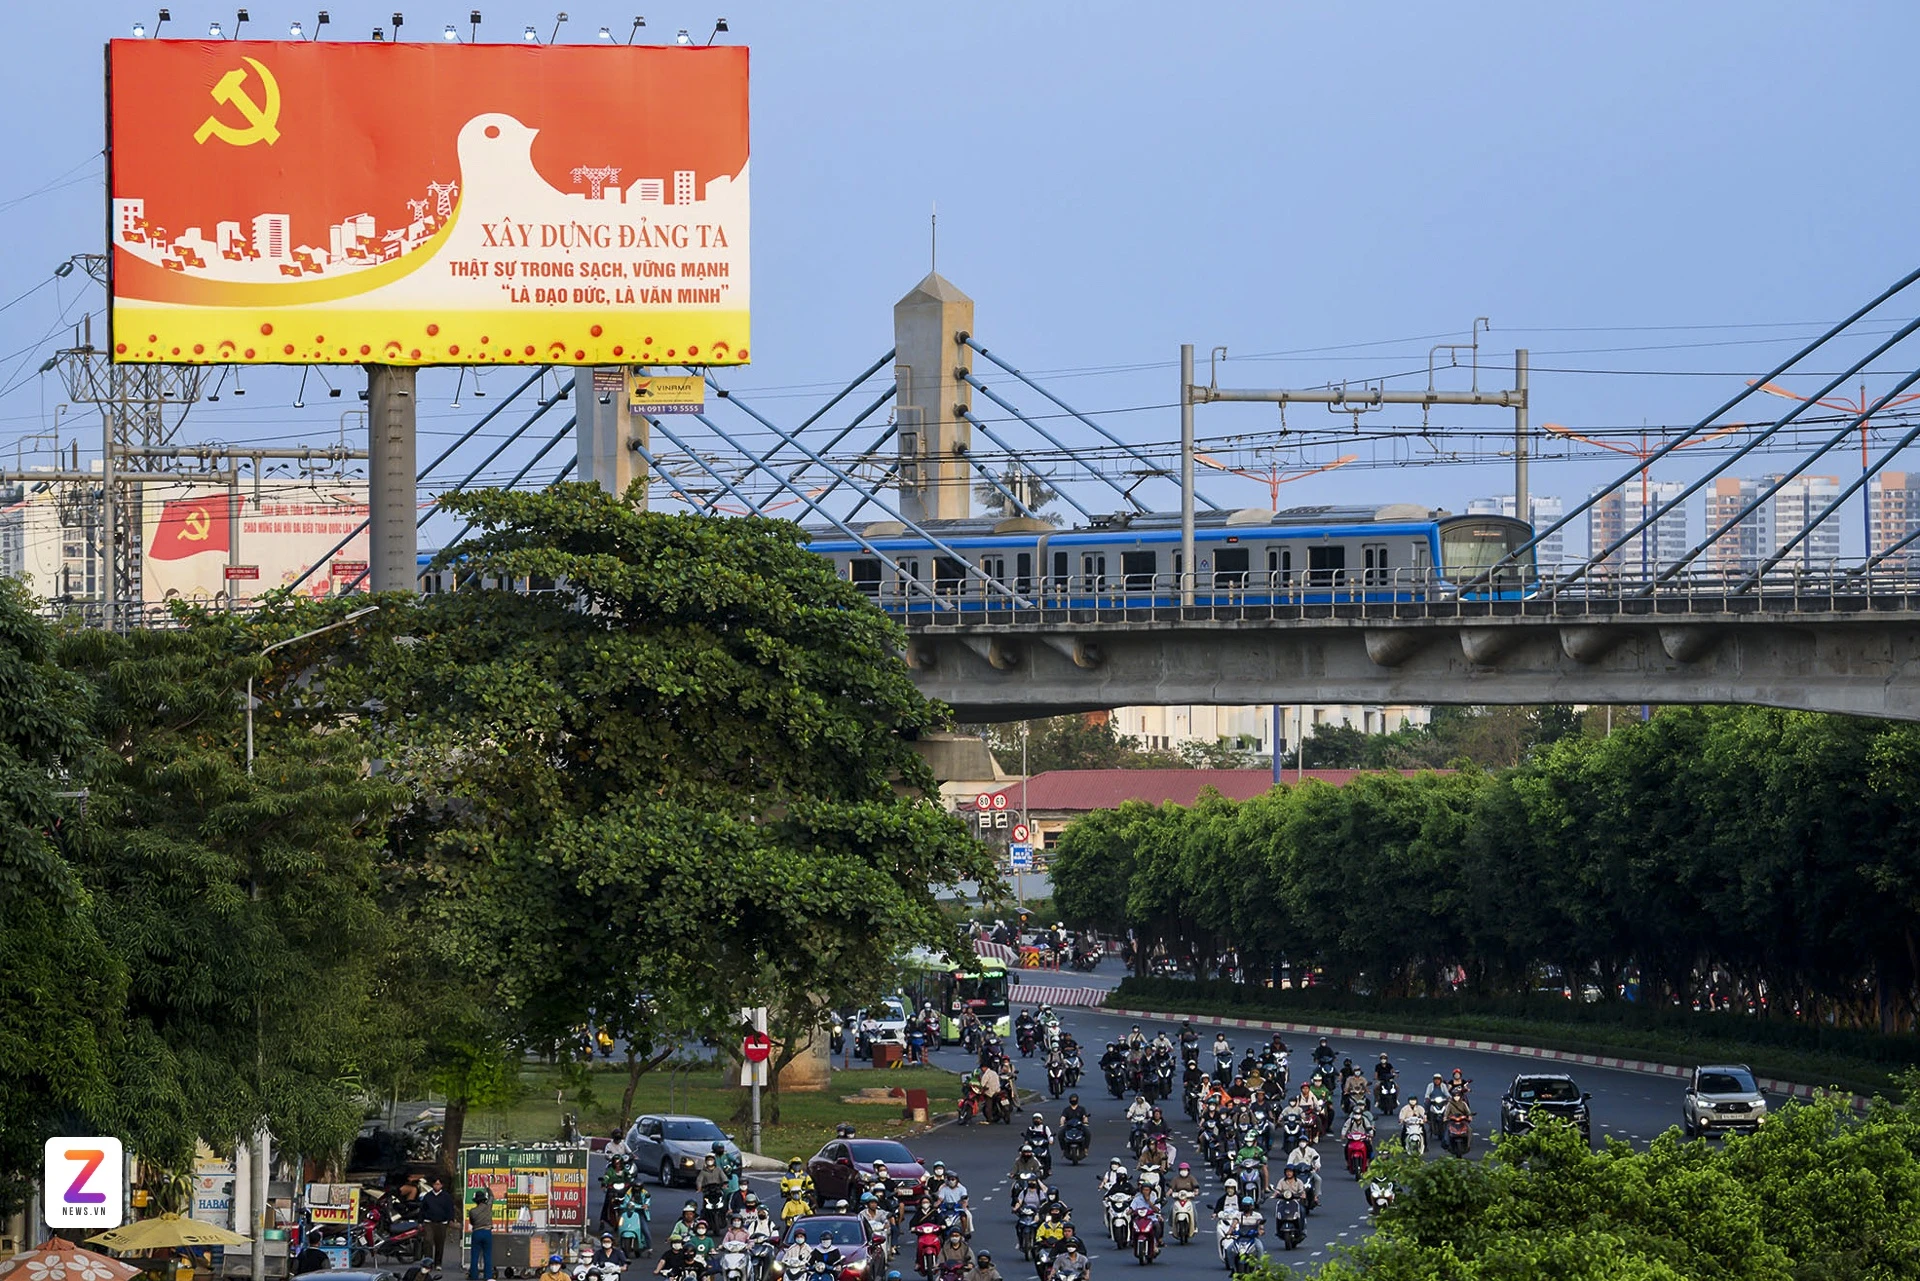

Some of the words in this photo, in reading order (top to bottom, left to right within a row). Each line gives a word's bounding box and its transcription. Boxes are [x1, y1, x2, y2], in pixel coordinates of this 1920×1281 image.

[481, 216, 533, 247] XÂY
[540, 220, 611, 254] DỰNG
[618, 216, 689, 249] ĐẢNG
[695, 224, 729, 248] TA
[449, 258, 489, 280] THẬT
[494, 260, 518, 280] SỰ
[520, 261, 574, 278] TRONG
[580, 262, 628, 281] SẠCH,
[632, 259, 676, 278] VỮNG
[681, 262, 729, 281] MẠNH
[535, 288, 568, 307] ĐẠO
[572, 285, 611, 305] ĐỨC,
[615, 285, 636, 304] LÀ
[640, 285, 673, 304] VĂN
[633, 405, 645, 413] LH
[646, 405, 666, 413] 0911
[679, 404, 699, 412] 5555
